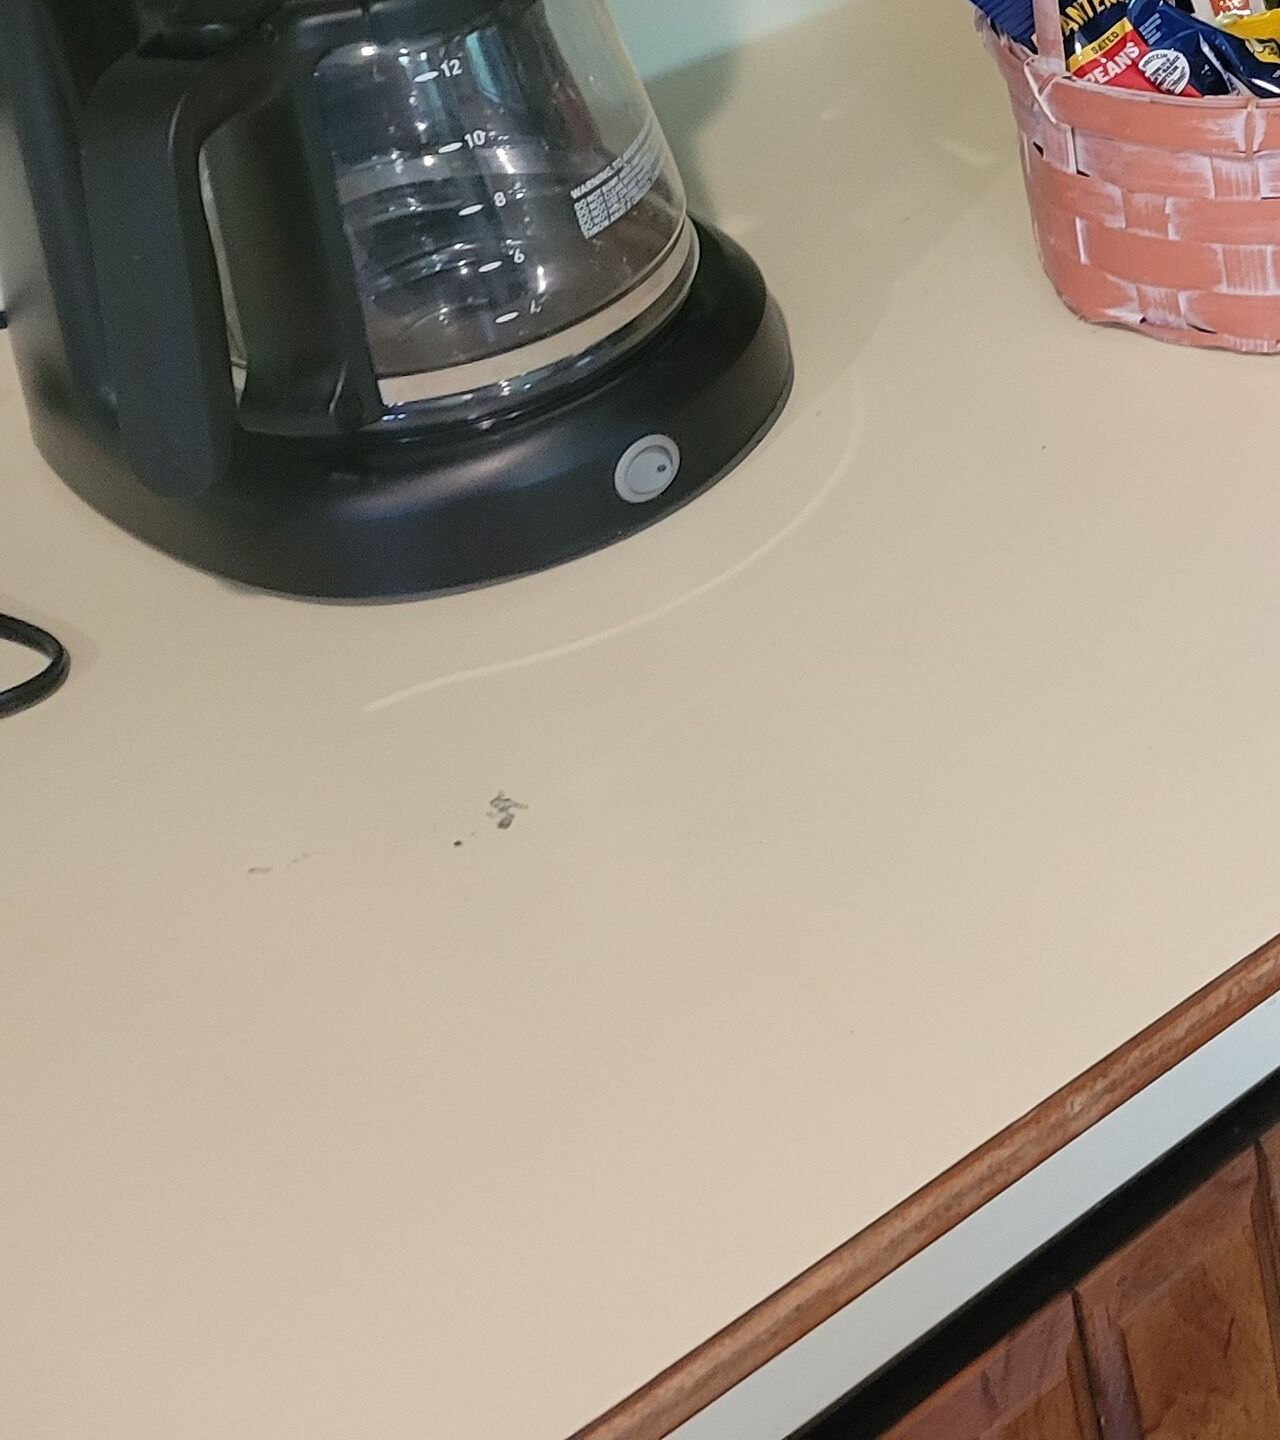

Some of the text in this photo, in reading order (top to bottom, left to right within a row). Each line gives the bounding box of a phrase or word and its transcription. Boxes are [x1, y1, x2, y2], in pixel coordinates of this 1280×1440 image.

[440, 59, 463, 78] 12
[463, 129, 485, 149] 10
[493, 191, 507, 207] 8
